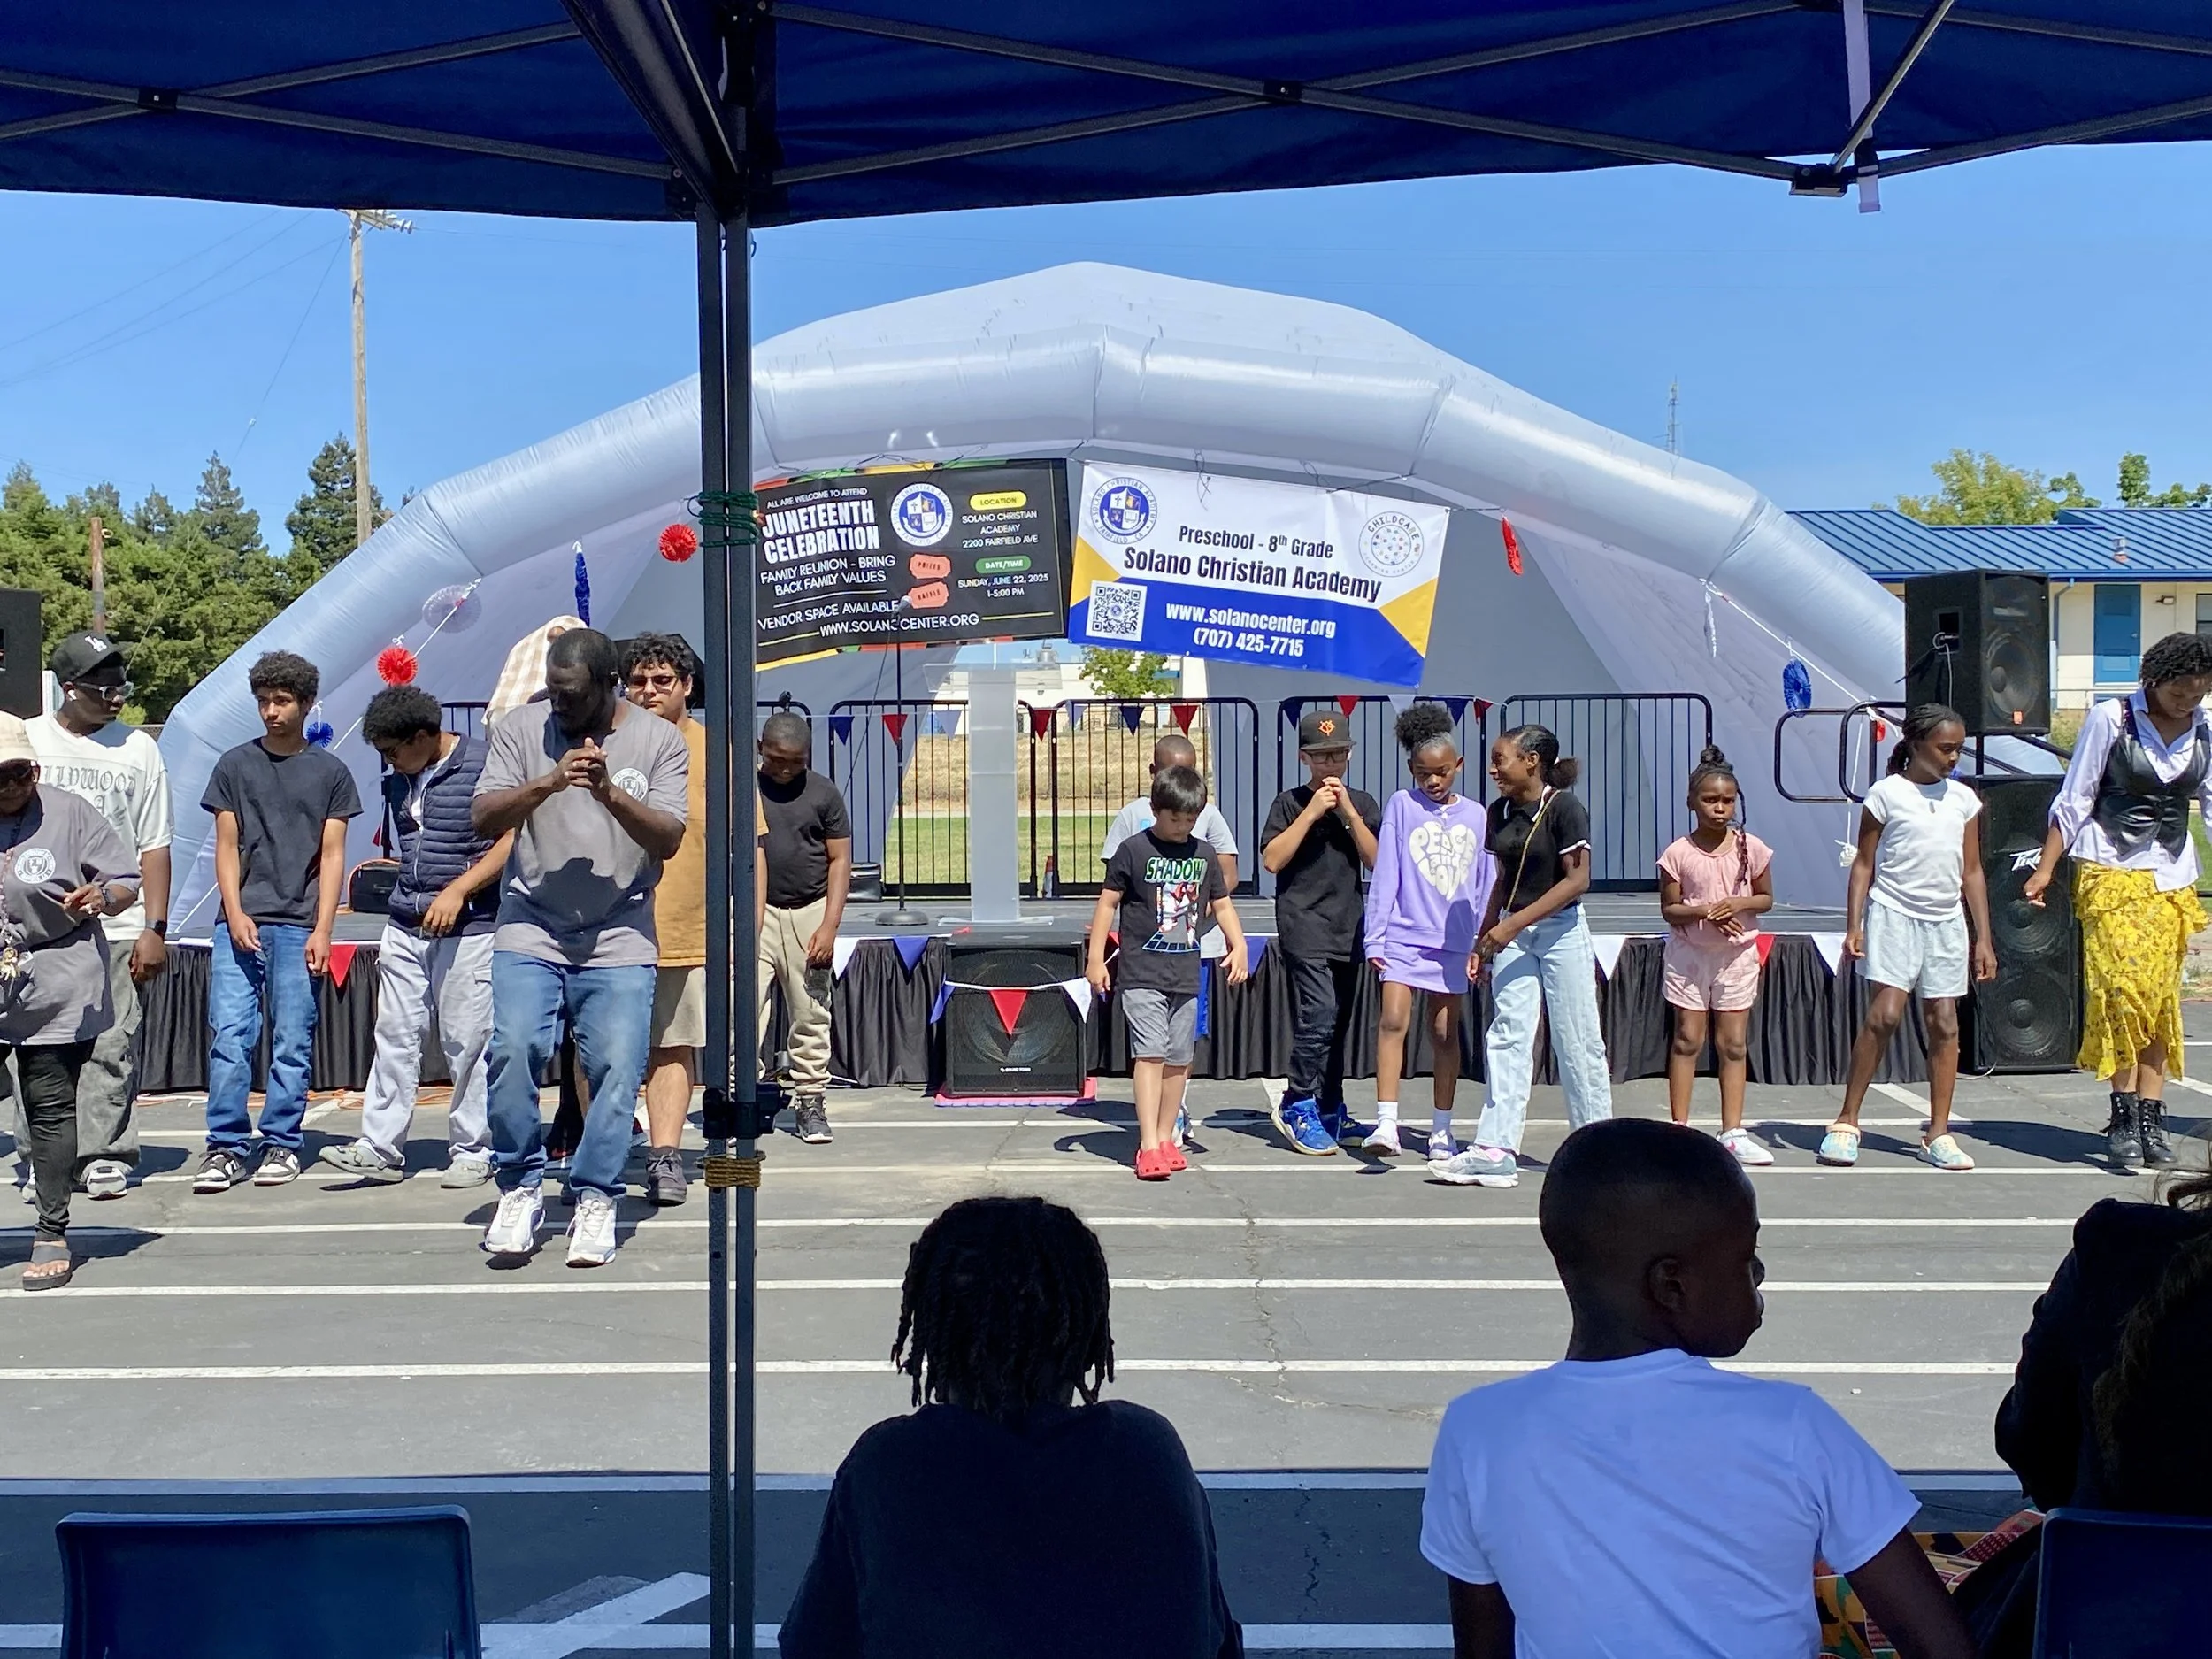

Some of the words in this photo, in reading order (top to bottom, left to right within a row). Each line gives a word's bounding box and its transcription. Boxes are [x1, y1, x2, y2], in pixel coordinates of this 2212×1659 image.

[767, 499, 780, 509] ALL
[780, 497, 794, 506] ARE
[795, 490, 829, 503] WELCOME
[841, 488, 867, 496] ATTEND
[980, 497, 1017, 506] LOCATION
[1092, 488, 1106, 516] SOLANO
[761, 499, 875, 538] JUNETEENTH
[962, 515, 995, 525] SOLANO
[996, 511, 1037, 520] CHRISTIAN
[980, 524, 1021, 534] ACADEMY
[1368, 515, 1420, 540] CHILDCARE
[764, 526, 880, 564] CELEBRATION
[962, 539, 984, 549] 2200
[985, 536, 1022, 547] FAIRFIELD
[1023, 534, 1039, 544] AVE
[1179, 525, 1256, 551] Preschool
[1269, 534, 1288, 552] 8th
[1291, 538, 1333, 559] Grade
[760, 565, 799, 584] FAMILY
[800, 557, 848, 576] REUNION
[859, 555, 895, 569] BRING
[985, 560, 1024, 570] DATE/TIME
[1123, 546, 1192, 579] Solano
[1196, 554, 1288, 588] Christian
[1292, 566, 1382, 603] Academy
[775, 580, 803, 596] BACK
[804, 573, 838, 590] FAMILY
[841, 571, 886, 583] VALUES
[957, 578, 991, 588] SUNDAY,
[992, 576, 1012, 586] JUNE
[1013, 575, 1027, 585] 22,
[1028, 573, 1049, 583] 2025
[987, 588, 1010, 598] 1-5:00
[1011, 587, 1025, 596] PM
[757, 612, 803, 630] VENDOR
[805, 605, 839, 621] SPACE
[842, 599, 900, 615] AVAILABLE
[1165, 603, 1335, 640] www.solanocenter.org
[1193, 626, 1233, 649] (707)
[1235, 634, 1304, 657] 425-7715
[44, 764, 136, 797] LLYWOOD
[1409, 821, 1477, 864] PEACE
[1145, 856, 1208, 886] SHADOW
[1418, 858, 1470, 901] LOVE
